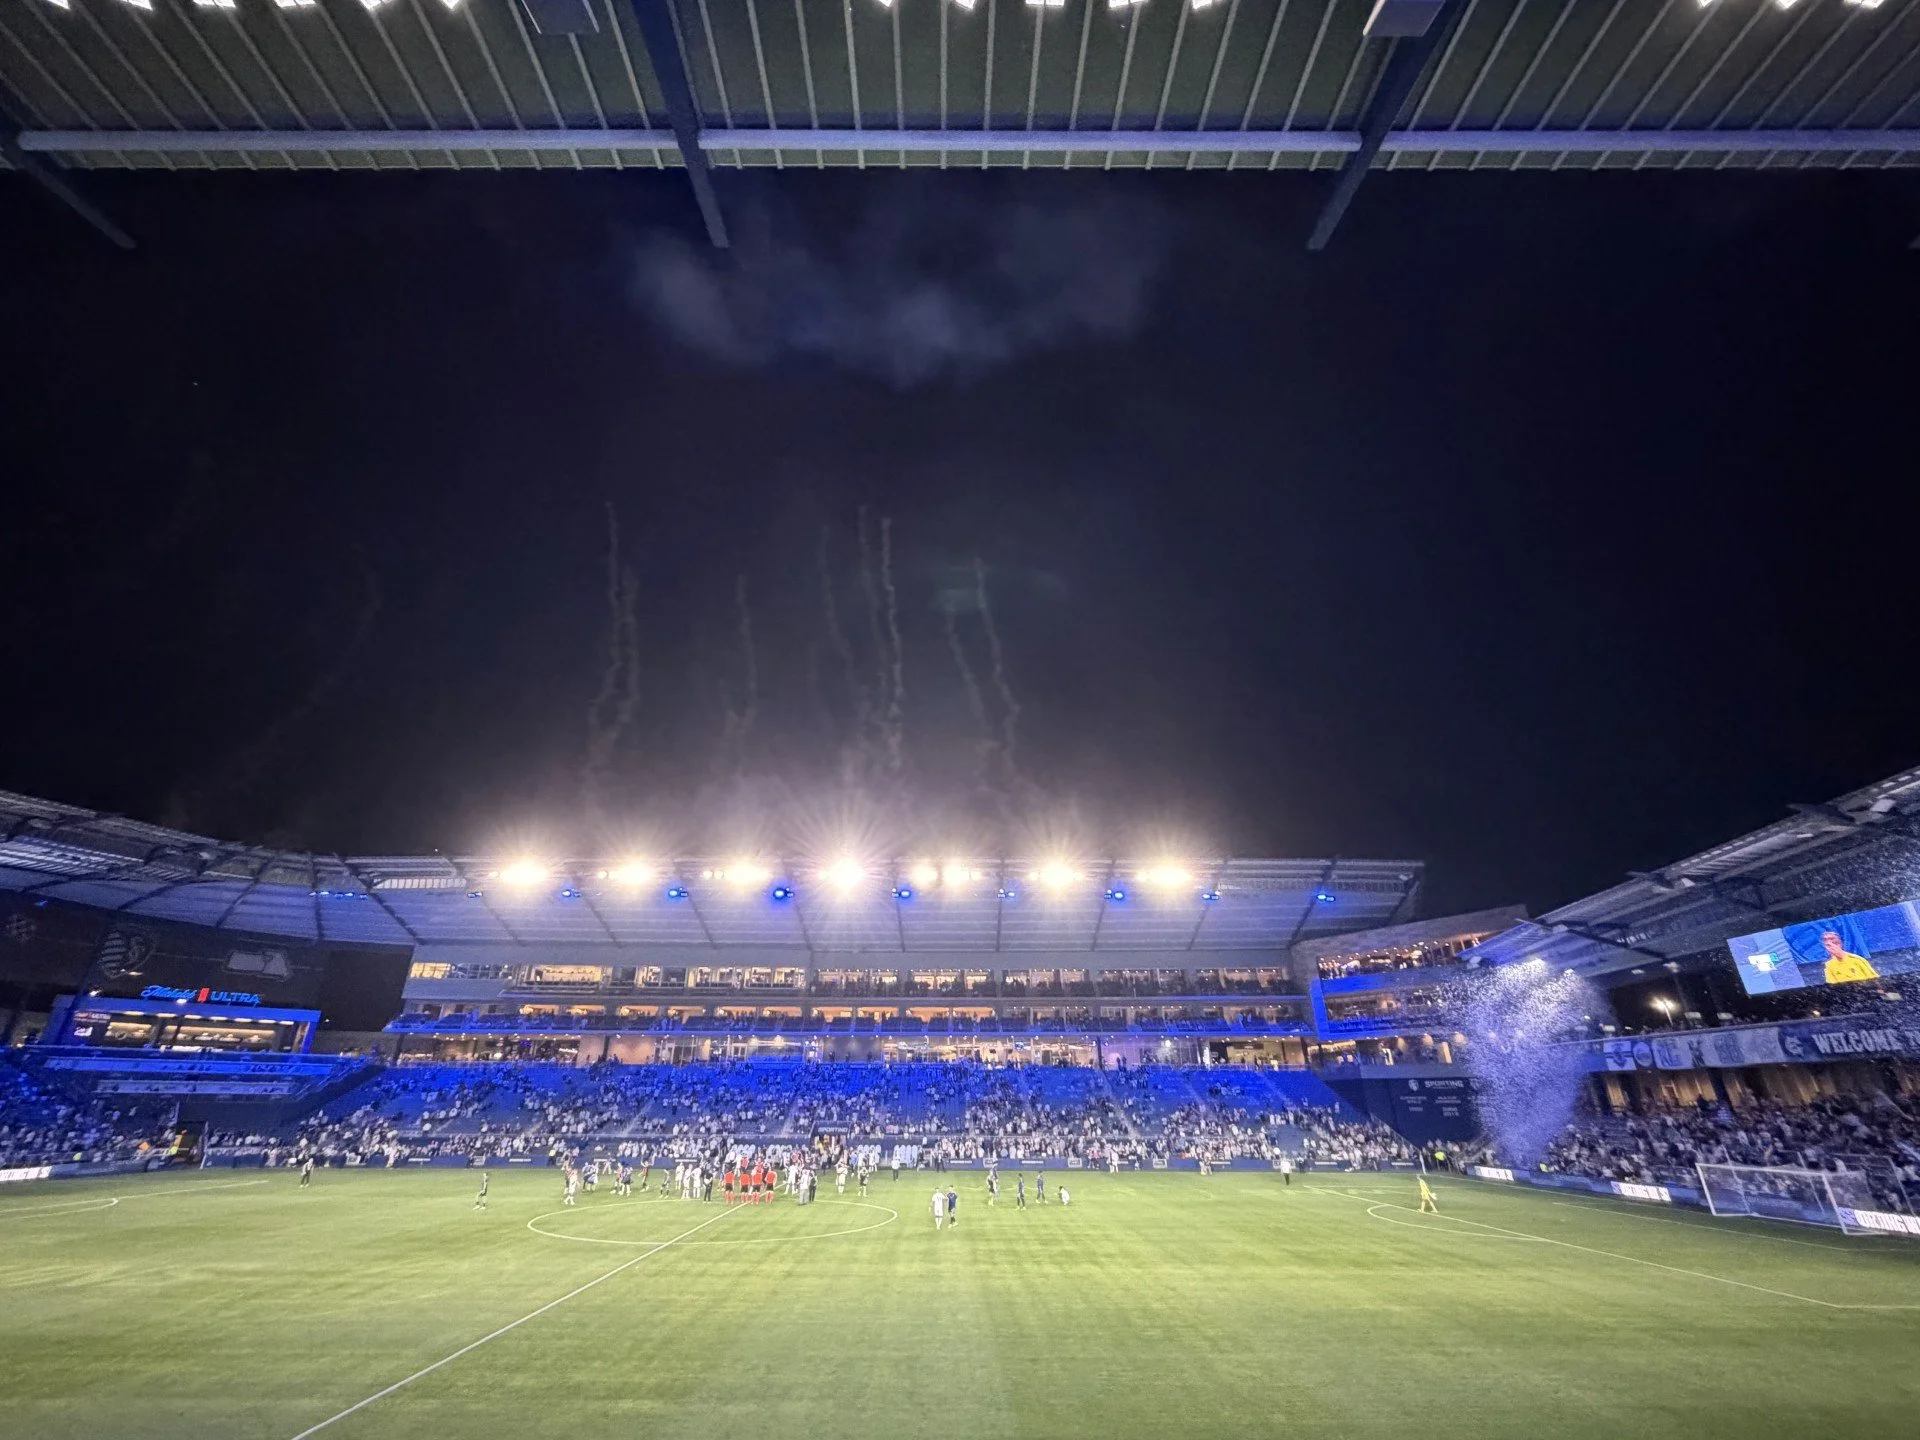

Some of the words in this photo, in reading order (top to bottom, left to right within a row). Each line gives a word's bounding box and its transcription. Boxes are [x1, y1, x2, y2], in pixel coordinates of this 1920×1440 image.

[211, 991, 260, 1003] ULTRA
[1812, 1029, 1902, 1054] WELCOME
[1424, 1080, 1464, 1088] SPORTING
